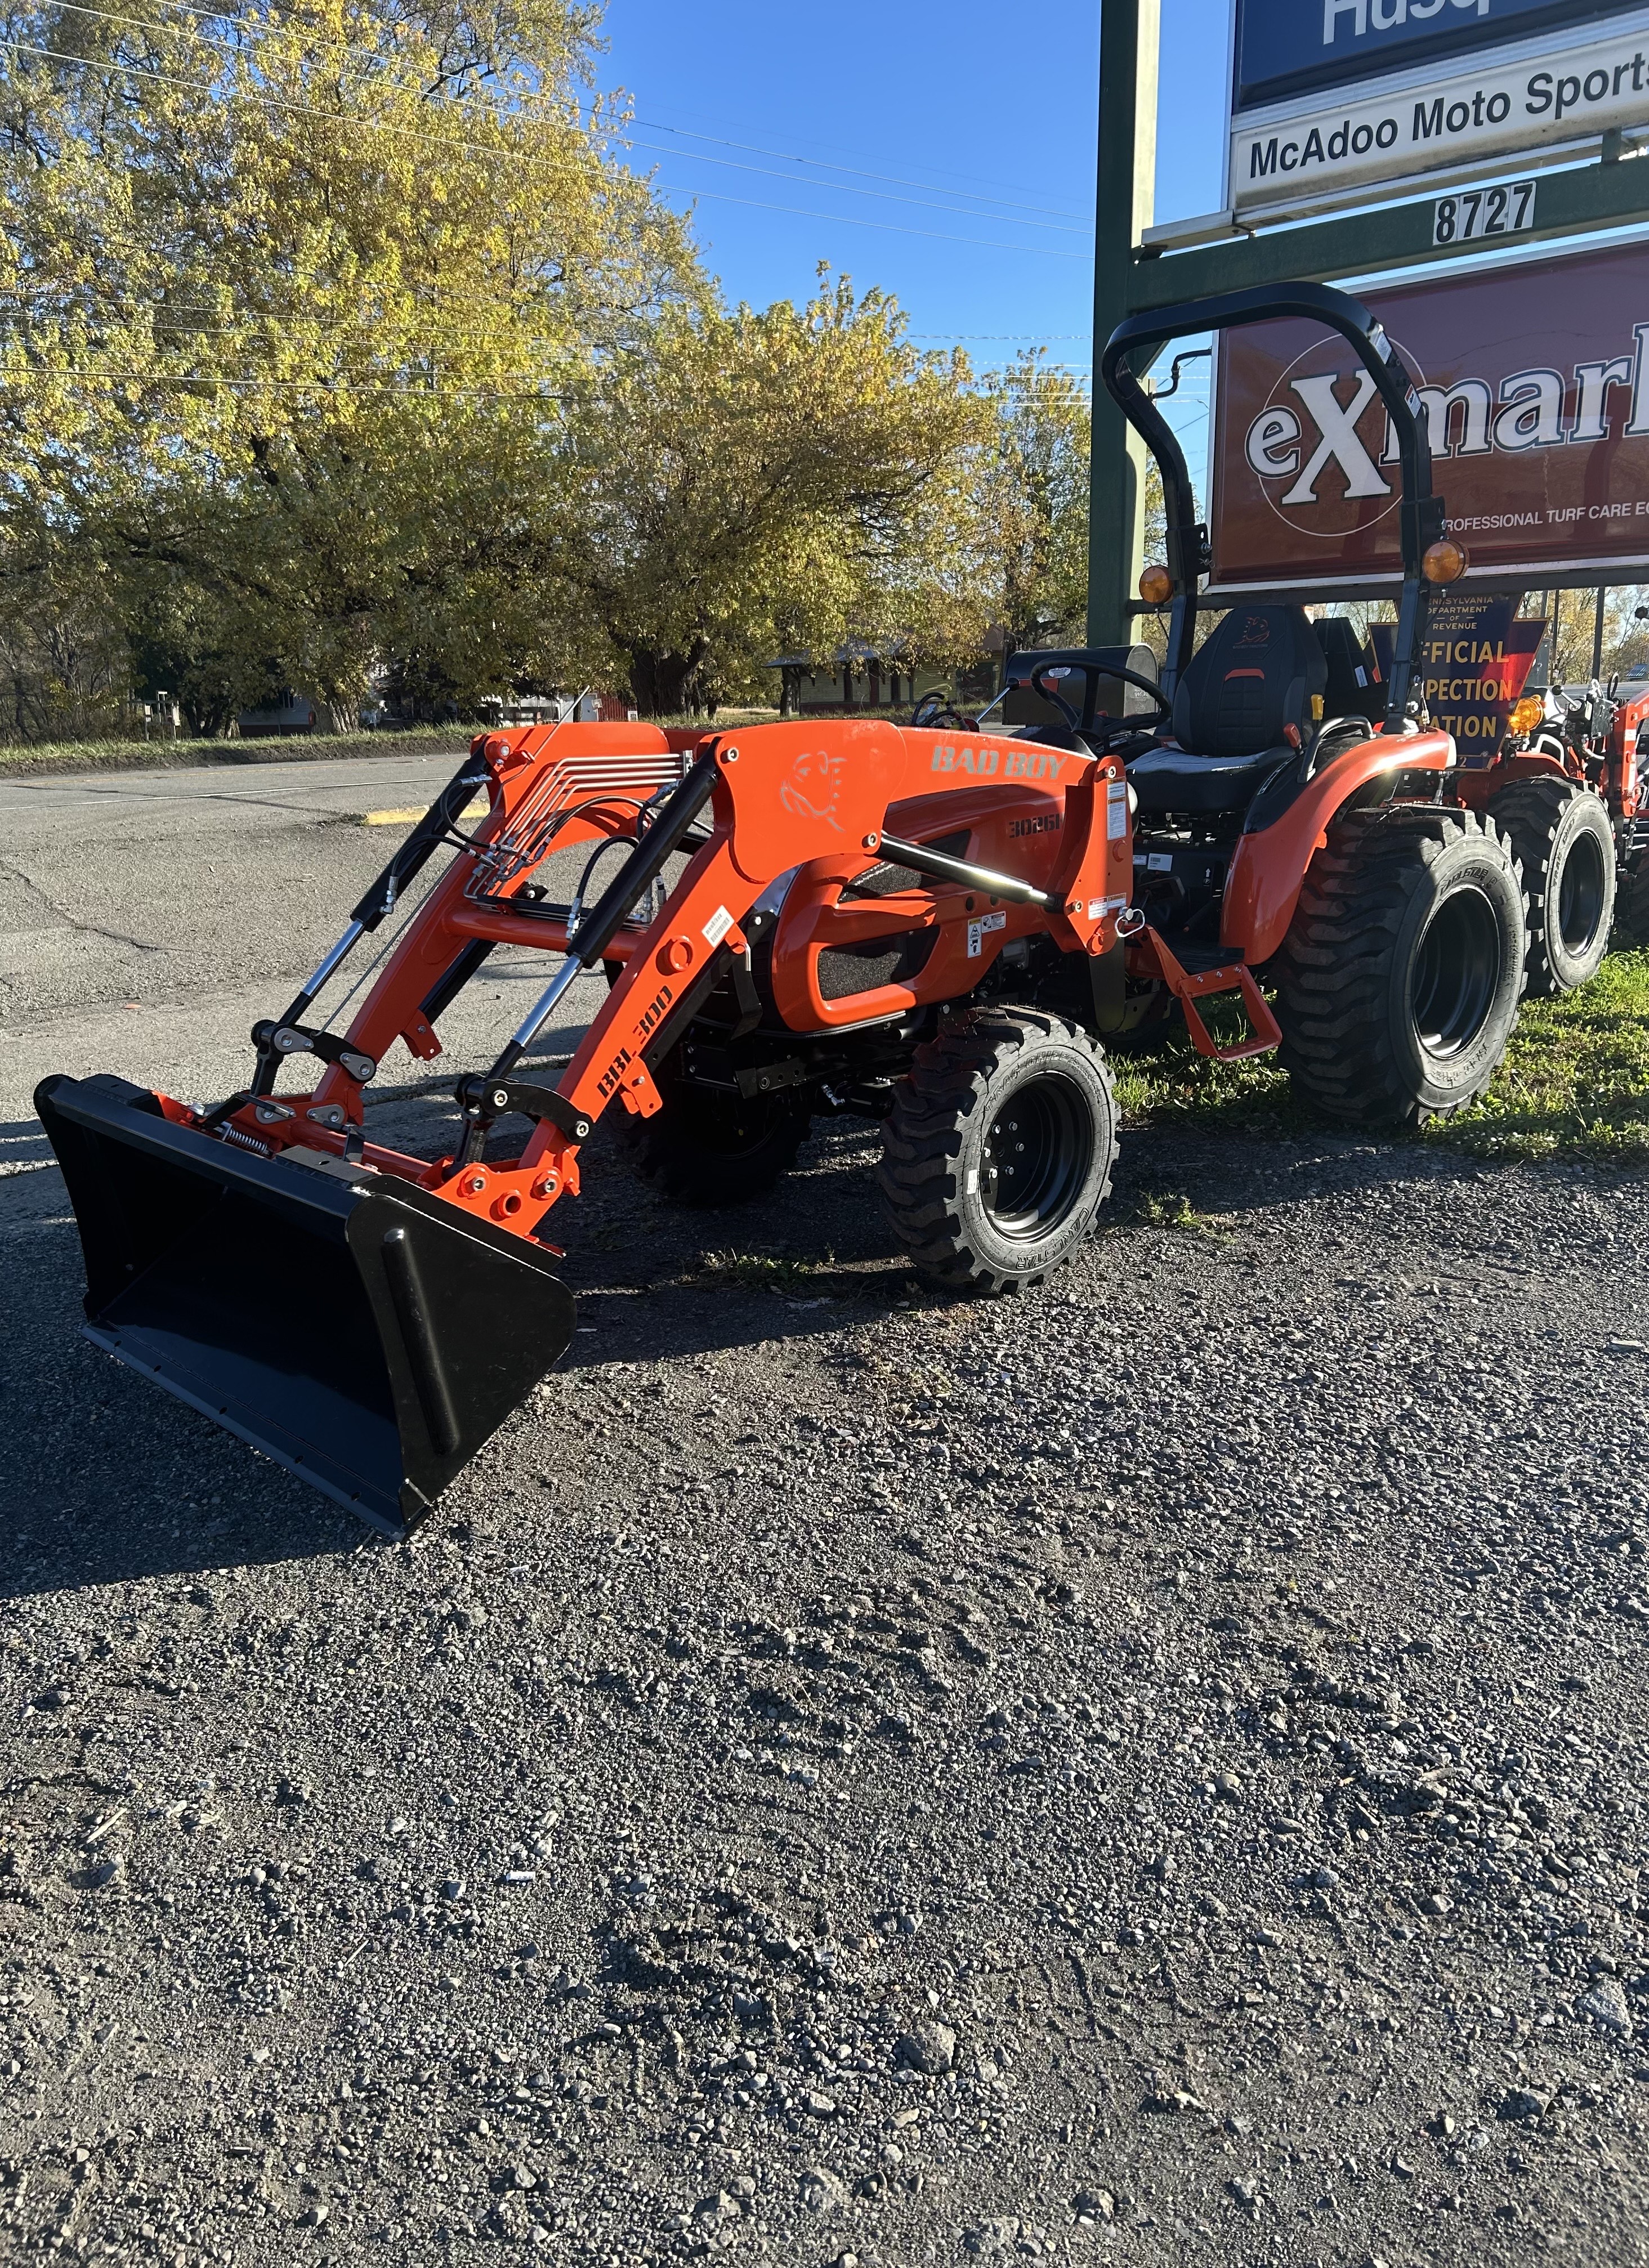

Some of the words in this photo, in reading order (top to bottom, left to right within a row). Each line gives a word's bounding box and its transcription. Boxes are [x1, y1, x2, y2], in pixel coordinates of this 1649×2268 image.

[1250, 118, 1398, 178] McAdoo
[1412, 90, 1511, 140] Moto
[1526, 52, 1649, 119] Sport
[1436, 185, 1533, 243] 8727
[1446, 512, 1543, 531] ROFESSIONAL
[1547, 507, 1586, 523] TURF
[1589, 503, 1632, 519] CARE
[931, 746, 999, 775] BAD
[1004, 751, 1068, 779] BOY
[597, 1048, 637, 1099] BBL
[632, 985, 673, 1045] 300
